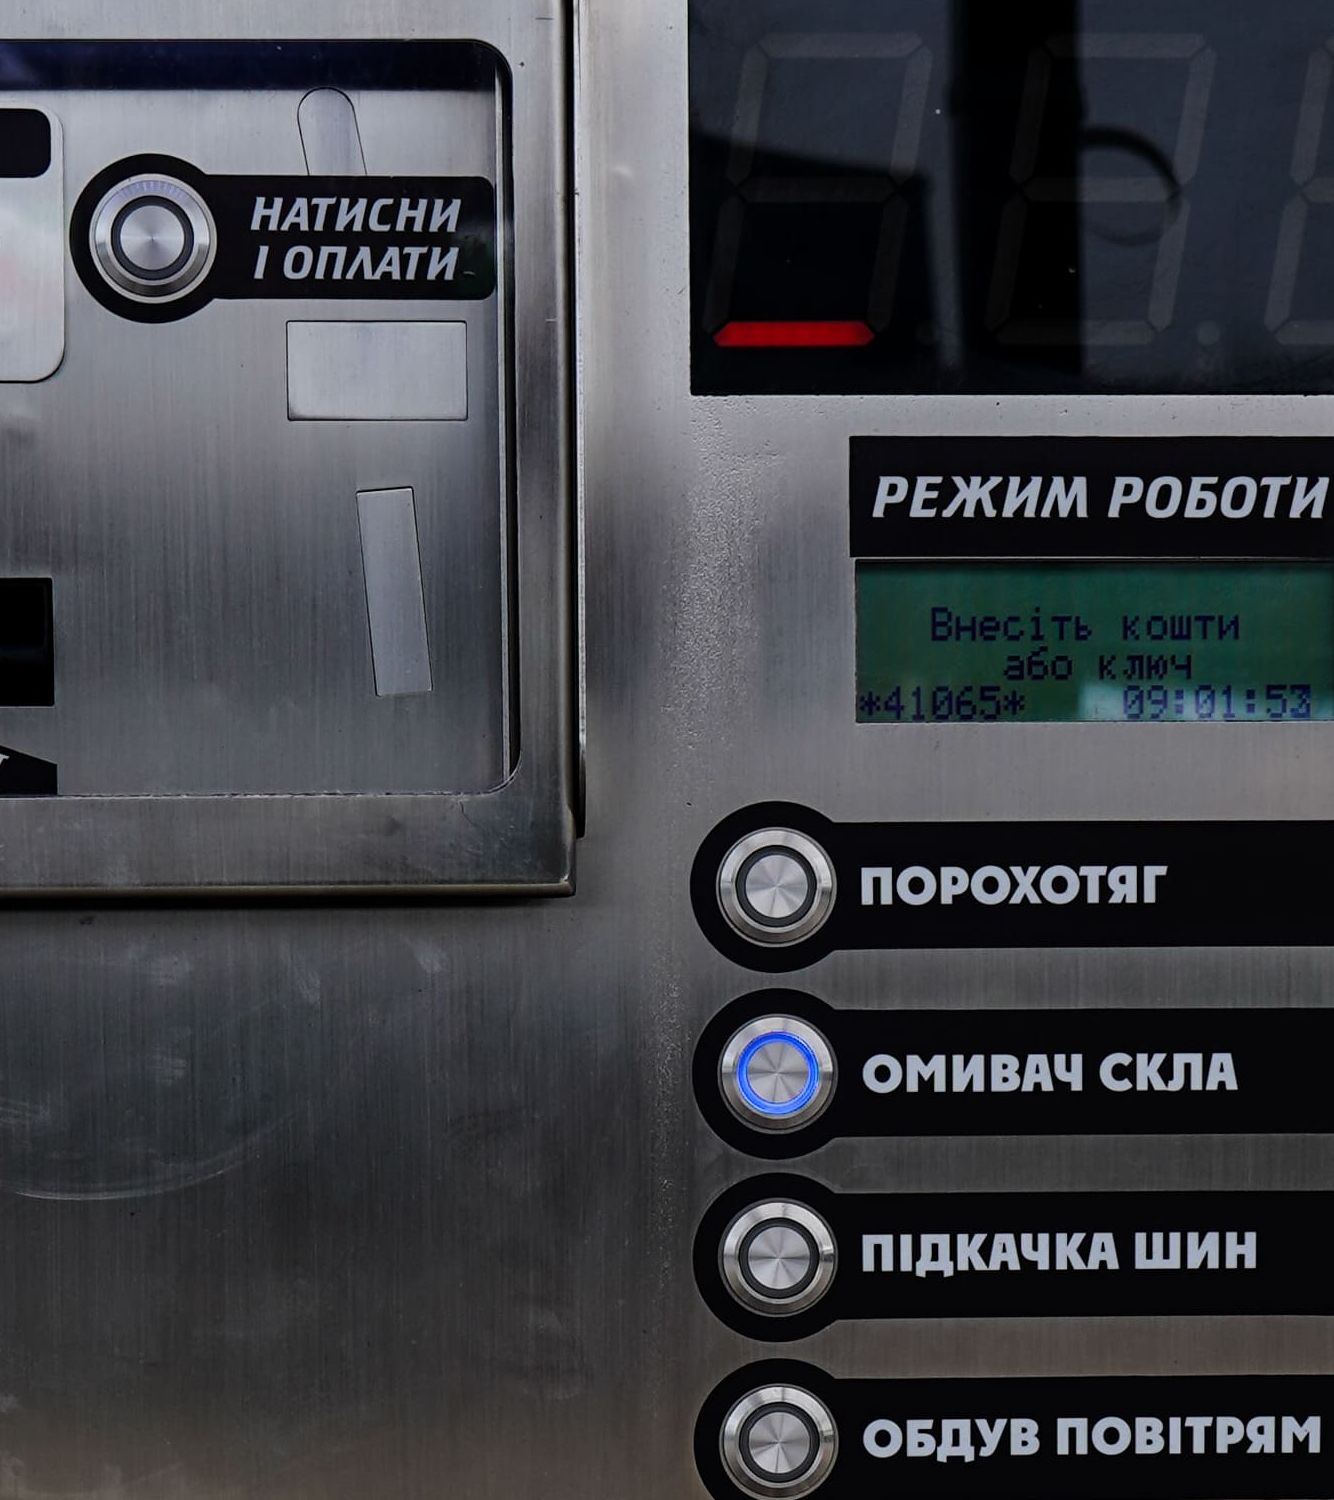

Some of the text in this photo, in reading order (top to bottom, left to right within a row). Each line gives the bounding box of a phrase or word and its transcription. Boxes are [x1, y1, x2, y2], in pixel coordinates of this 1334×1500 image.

[251, 197, 461, 232] НАТИСНИ
[284, 246, 459, 280] ОПЛАТИ
[873, 476, 1329, 518] РЕЖИМ РОБОТИ
[930, 607, 1241, 641] Внесіть кошти
[1003, 646, 1193, 681] або ключ
[861, 865, 1168, 905] ПОРОХОТЯГ
[863, 1053, 1238, 1093] ОМИВАЧ СКЛА
[862, 1232, 1256, 1277] ПІДКАЧКА ШИН
[863, 1416, 1320, 1462] ОБДУВ ПОВІТРЯМ
